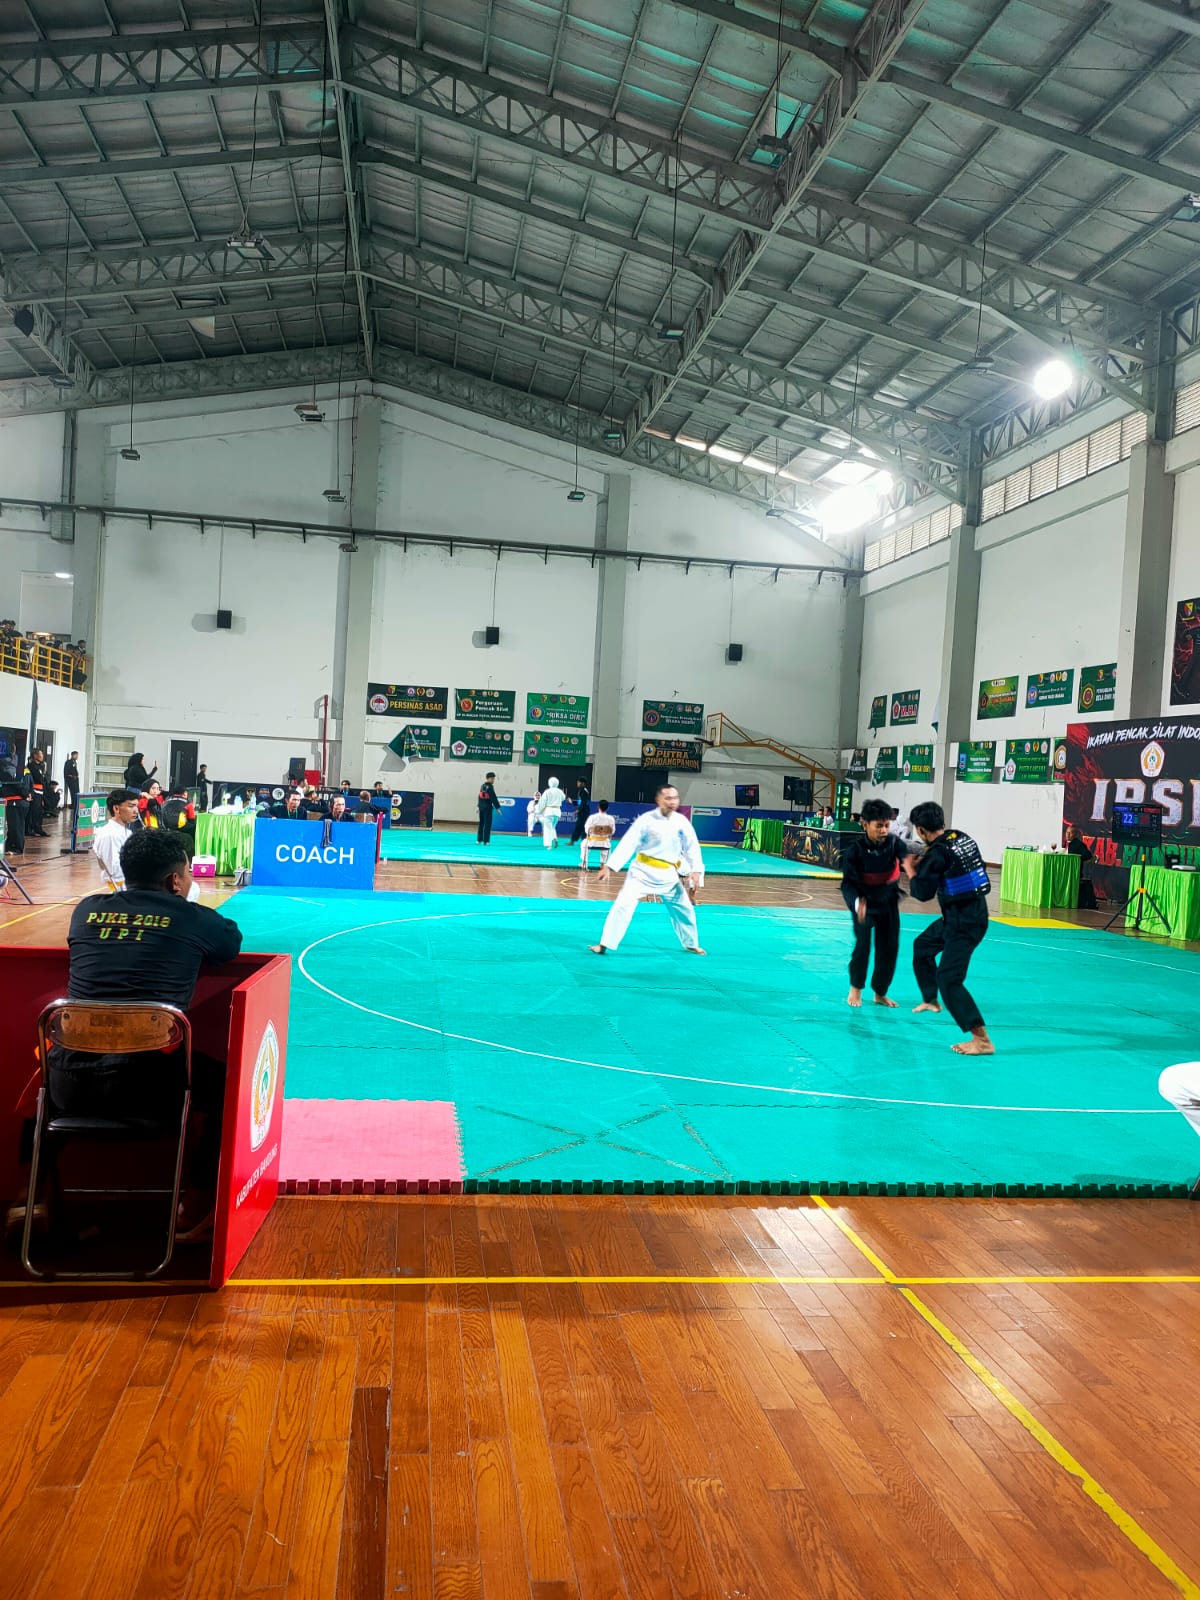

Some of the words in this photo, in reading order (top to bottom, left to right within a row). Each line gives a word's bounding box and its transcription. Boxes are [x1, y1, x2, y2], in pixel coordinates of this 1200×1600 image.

[389, 701, 423, 710] PERSINAS
[425, 702, 443, 711] ASAD
[1086, 730, 1114, 749] IKATAN
[1115, 727, 1149, 742] PENCAK
[656, 750, 689, 759] PUTRA
[843, 786, 850, 795] 3
[842, 797, 849, 807] 2
[842, 810, 847, 819] 1
[1123, 813, 1133, 824] 22
[275, 843, 355, 865] COACH
[86, 912, 128, 925] PJKR
[235, 1166, 261, 1210] KABUPATEN
[259, 1143, 278, 1177] BANDUNG
